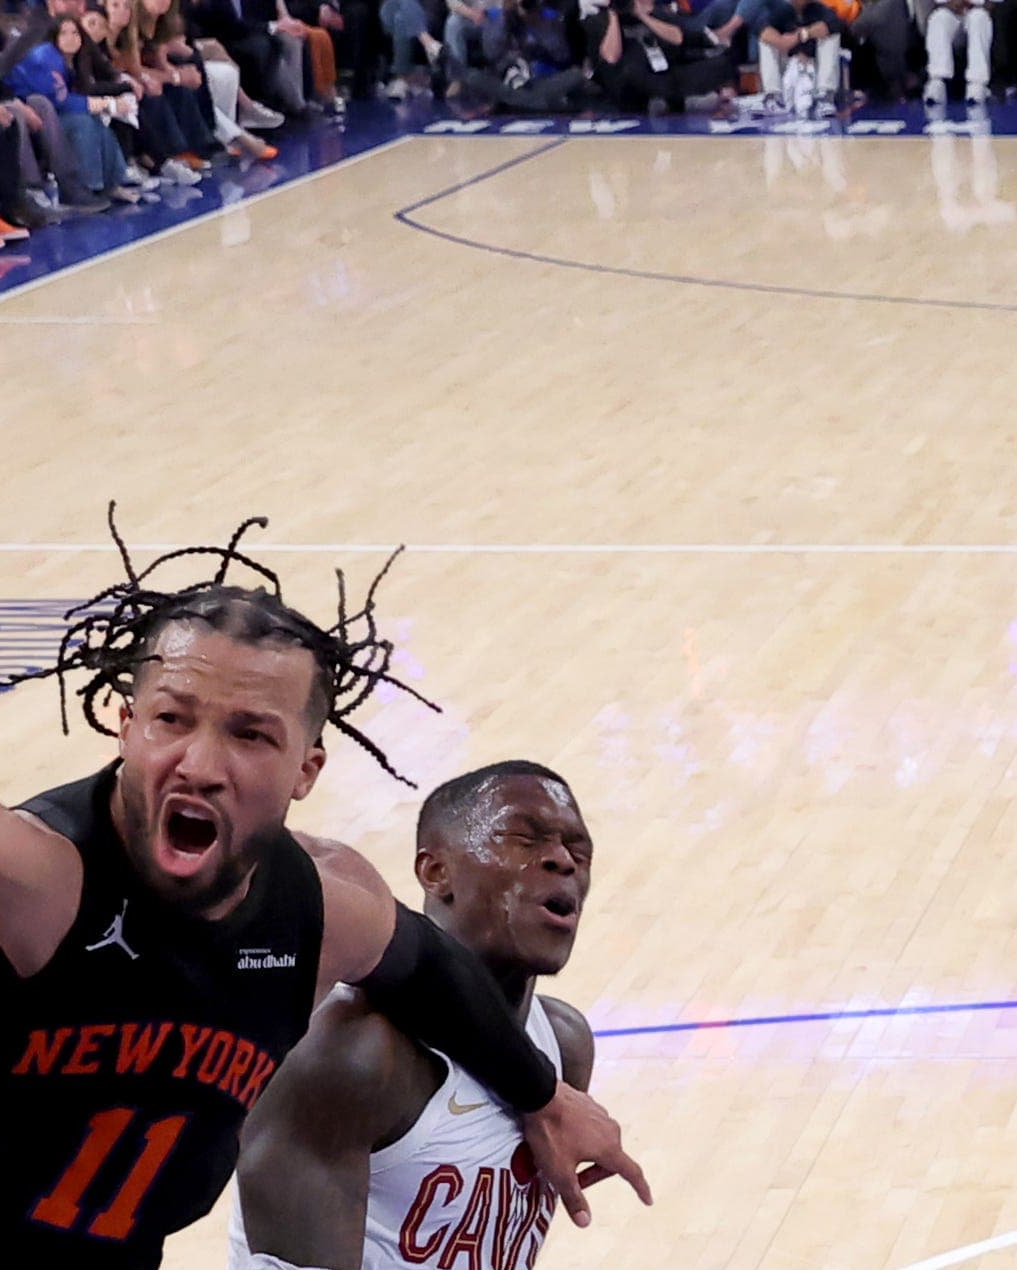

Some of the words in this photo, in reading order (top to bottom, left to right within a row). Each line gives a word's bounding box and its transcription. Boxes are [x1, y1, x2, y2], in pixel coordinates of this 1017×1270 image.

[11, 1022, 174, 1075] NEW
[172, 1023, 278, 1110] YORK
[31, 1107, 188, 1240] 11
